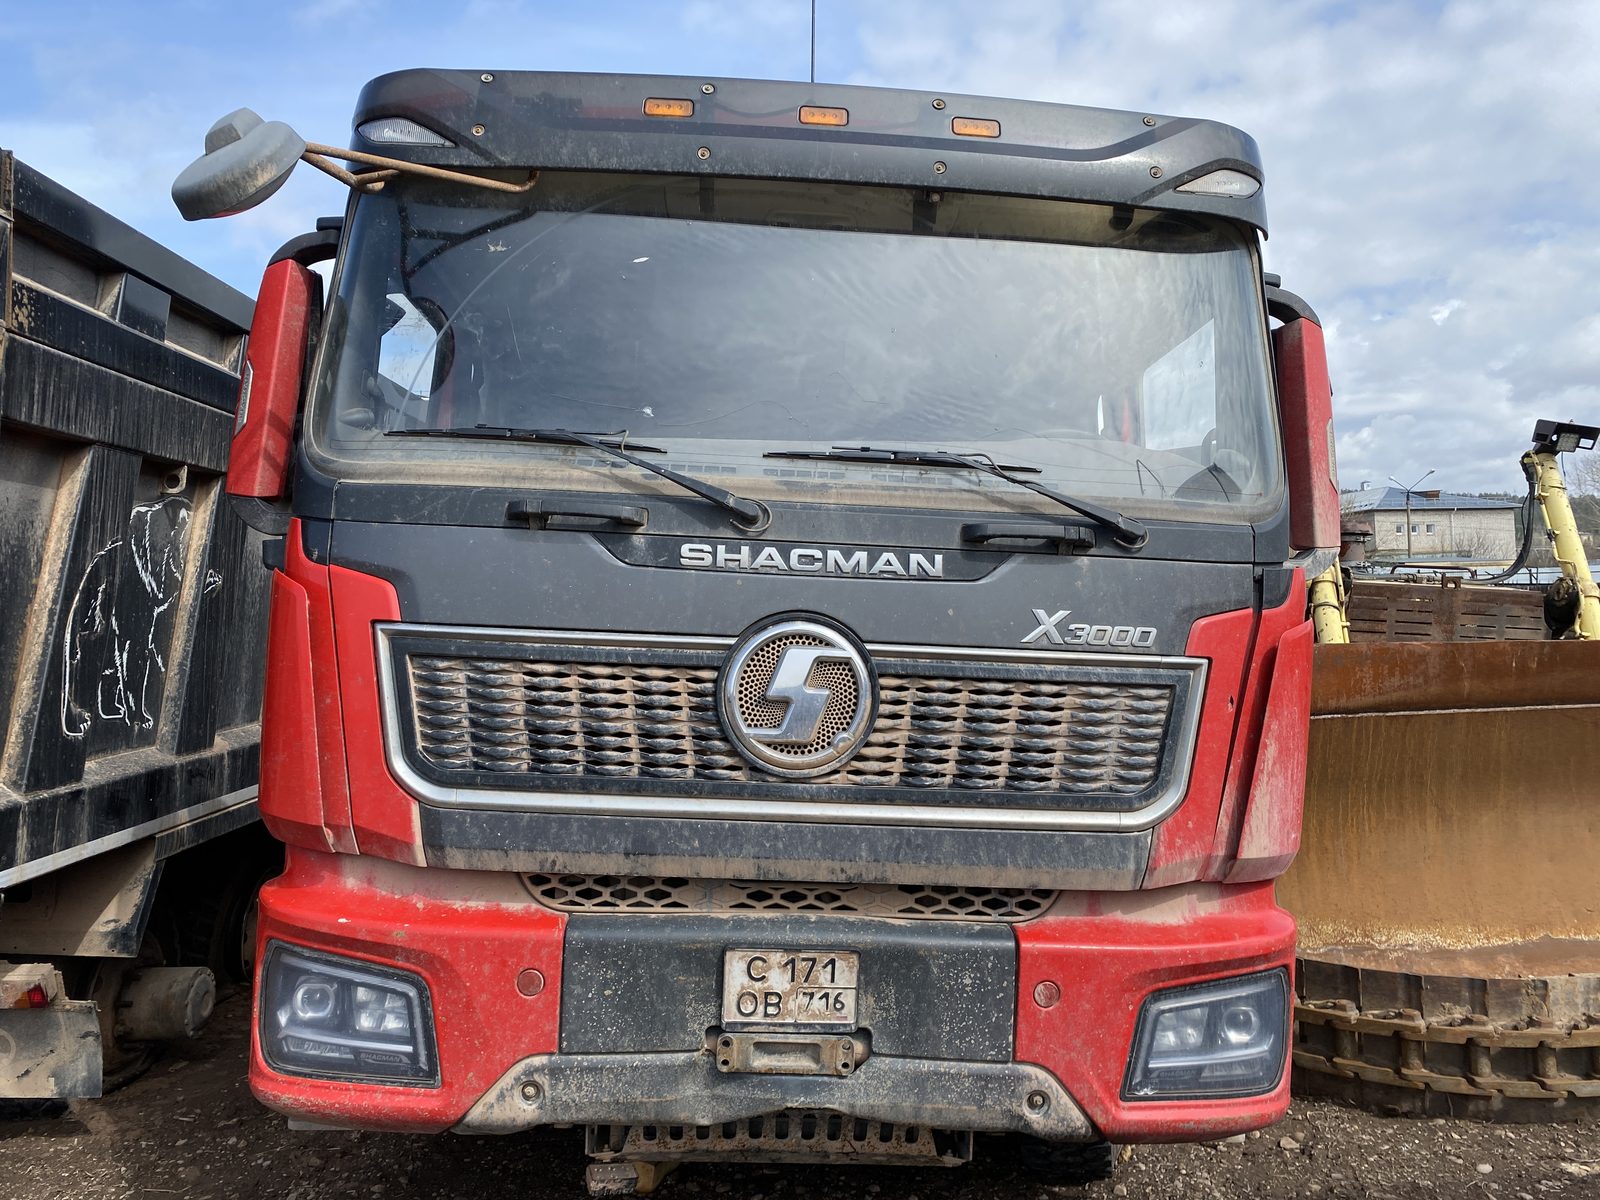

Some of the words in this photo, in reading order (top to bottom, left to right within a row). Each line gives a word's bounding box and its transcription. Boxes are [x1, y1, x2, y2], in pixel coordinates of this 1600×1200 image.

[680, 543, 943, 578] SHACMAN
[1020, 608, 1158, 647] X3000
[782, 957, 836, 984] 171
[803, 991, 846, 1012] 716
